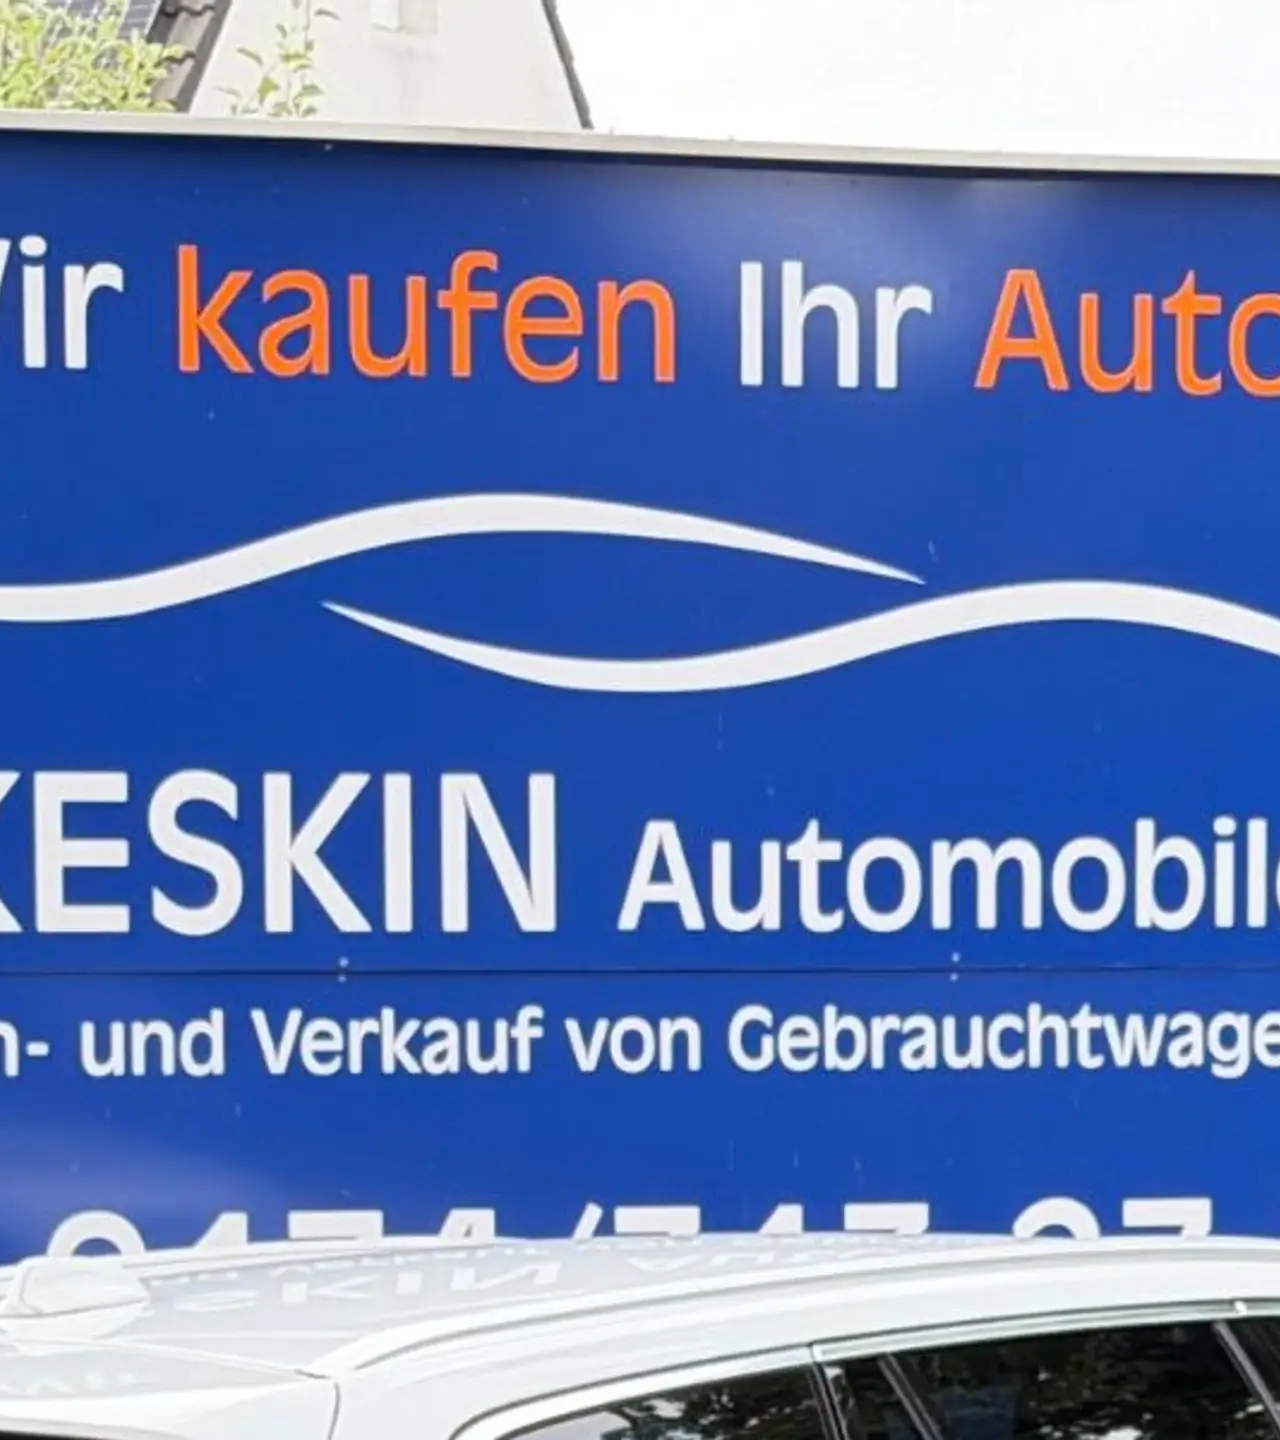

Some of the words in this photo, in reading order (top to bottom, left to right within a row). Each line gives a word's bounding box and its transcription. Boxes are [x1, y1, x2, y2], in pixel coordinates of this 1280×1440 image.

[177, 244, 676, 385] kaufen
[738, 260, 934, 390] Ihr
[80, 1006, 225, 1078] und
[250, 1004, 544, 1077] Verkauf
[564, 1016, 701, 1075] von
